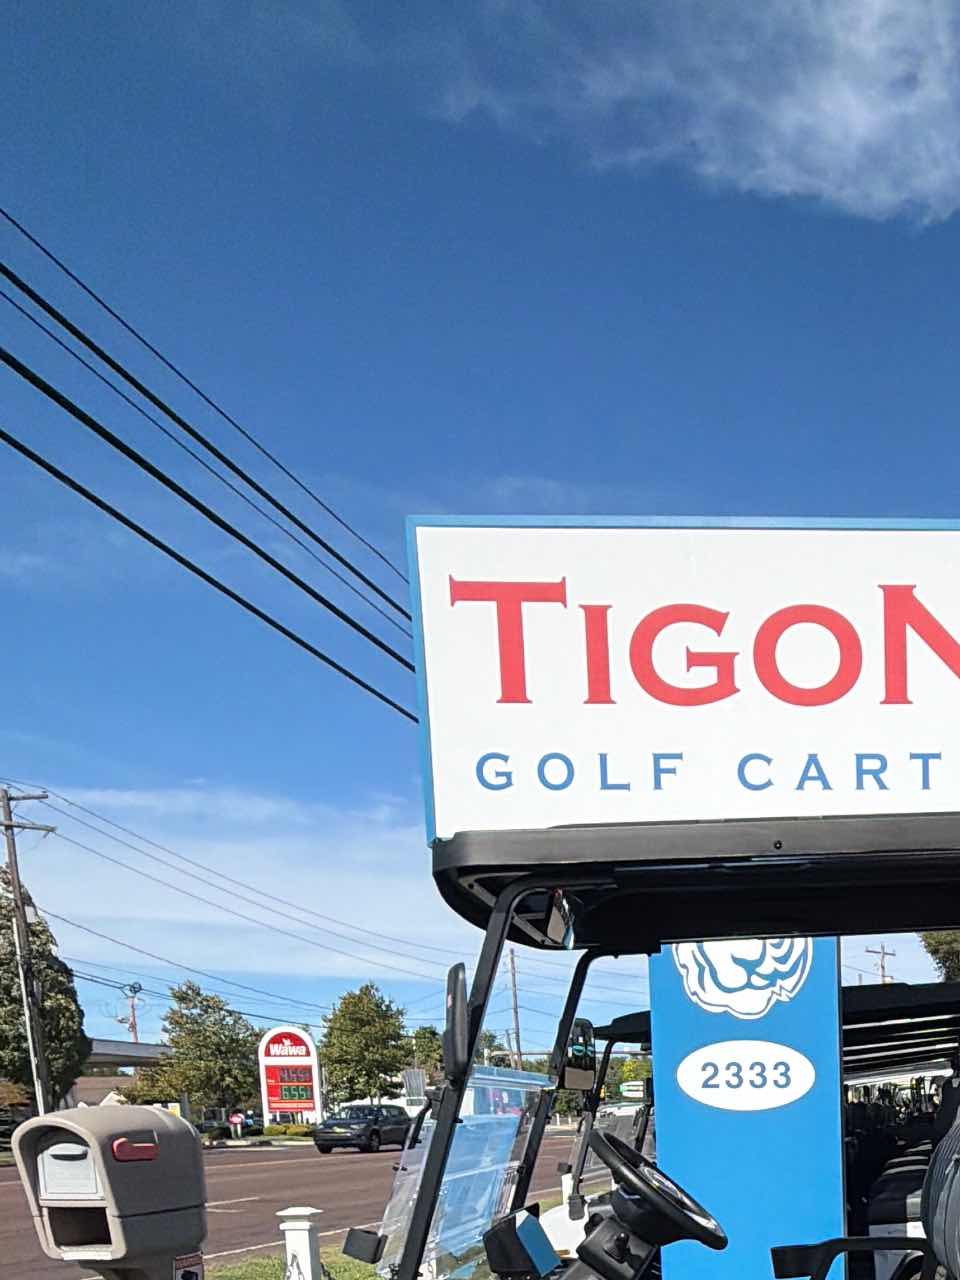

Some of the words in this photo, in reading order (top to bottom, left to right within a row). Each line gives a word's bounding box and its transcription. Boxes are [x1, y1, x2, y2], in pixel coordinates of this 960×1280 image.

[475, 752, 683, 791] GOLF
[270, 1043, 306, 1056] Wawa
[701, 1061, 792, 1089] 2333
